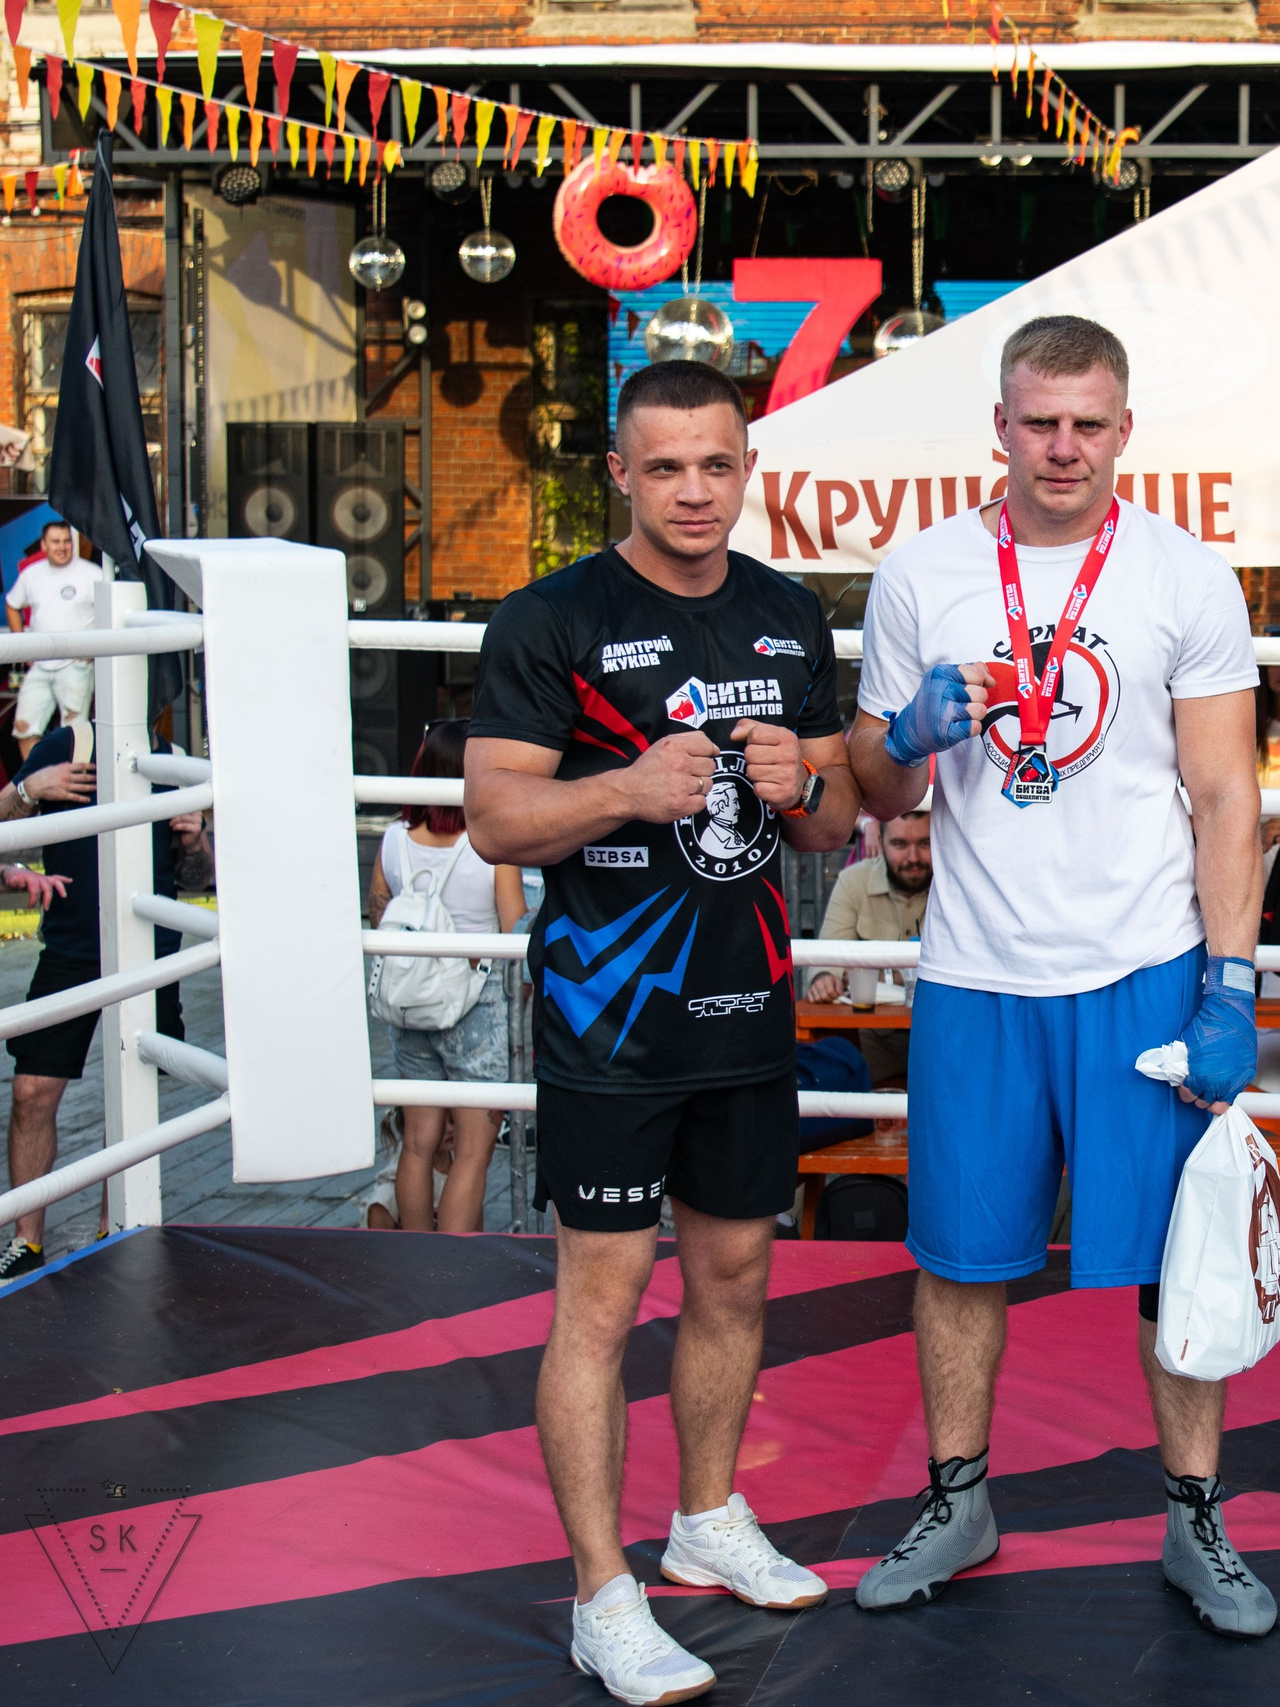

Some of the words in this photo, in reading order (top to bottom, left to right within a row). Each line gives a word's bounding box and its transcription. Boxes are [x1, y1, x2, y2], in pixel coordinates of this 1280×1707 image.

[761, 448, 1236, 560] КРУШЦЕ
[602, 635, 674, 659] ДМИТРИЙ
[992, 624, 1109, 659] СРАТ
[602, 652, 661, 673] ЖУКОВ
[706, 679, 783, 706] БИТВА
[1015, 784, 1051, 795] БИТВА
[587, 850, 646, 864] SIBSA
[694, 848, 763, 874] 2010
